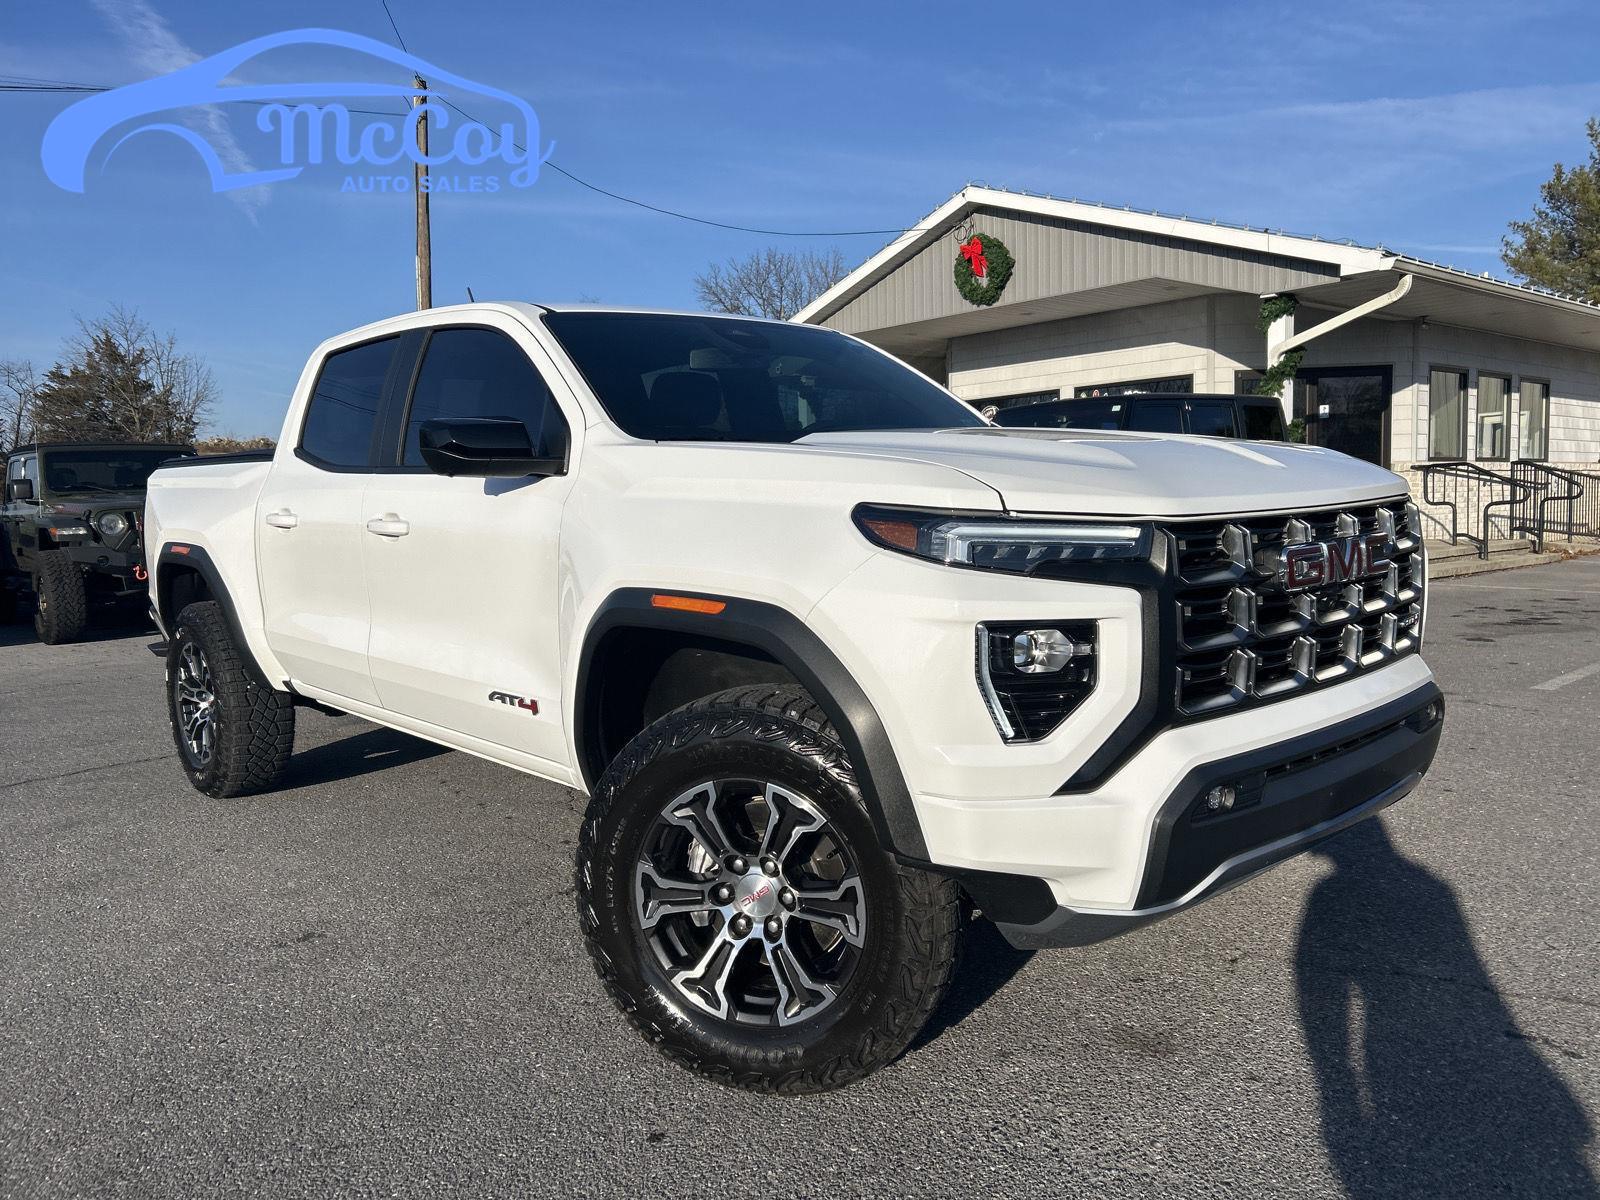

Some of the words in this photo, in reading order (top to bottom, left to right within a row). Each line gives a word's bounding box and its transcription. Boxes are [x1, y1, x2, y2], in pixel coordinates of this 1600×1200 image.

[1280, 532, 1391, 591] GMC
[488, 691, 539, 716] AT4
[740, 885, 770, 907] GMC
